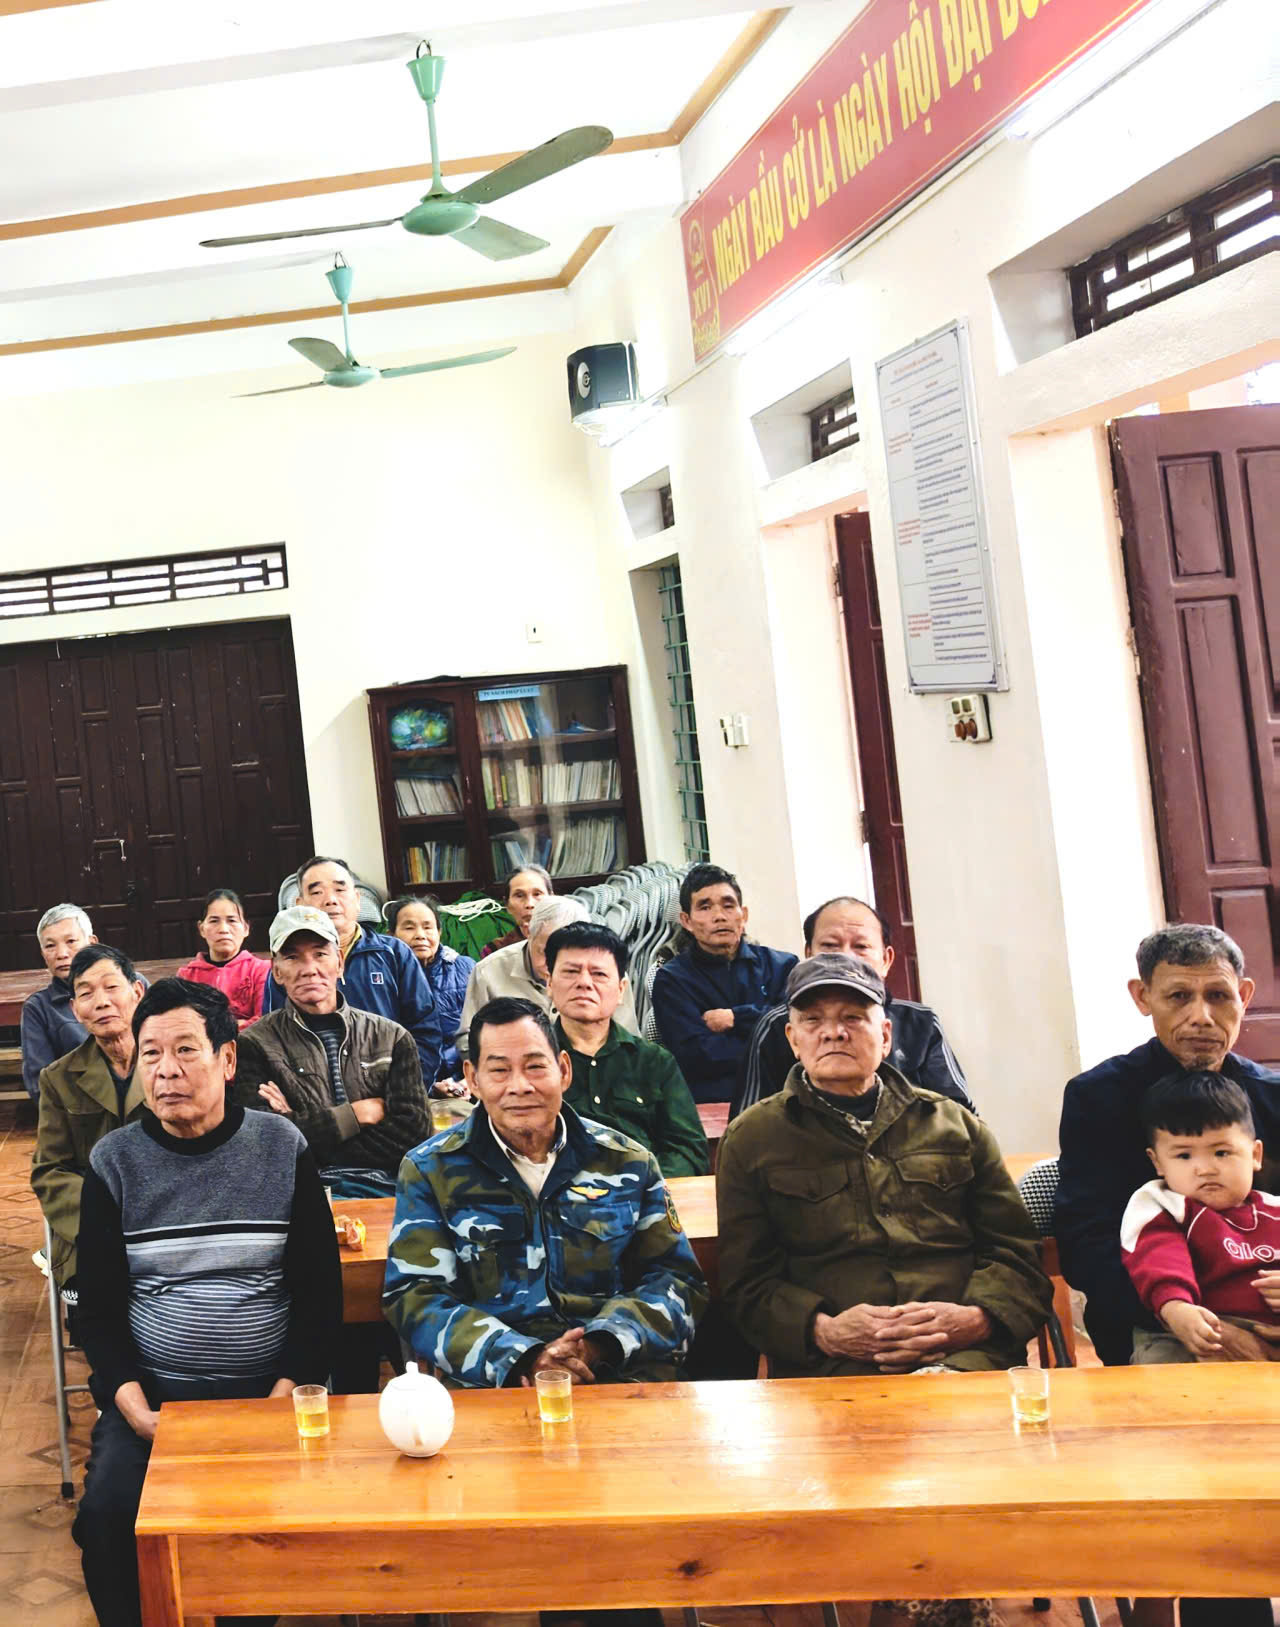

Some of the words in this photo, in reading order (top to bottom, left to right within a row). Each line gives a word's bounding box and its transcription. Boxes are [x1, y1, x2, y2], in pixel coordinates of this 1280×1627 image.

[712, 194, 751, 295] NGÀY
[749, 149, 784, 262] BẦU
[783, 114, 810, 230] CỬ
[807, 99, 838, 208] LÀ
[833, 51, 893, 185] NGÀY
[892, 0, 941, 135] HỘI
